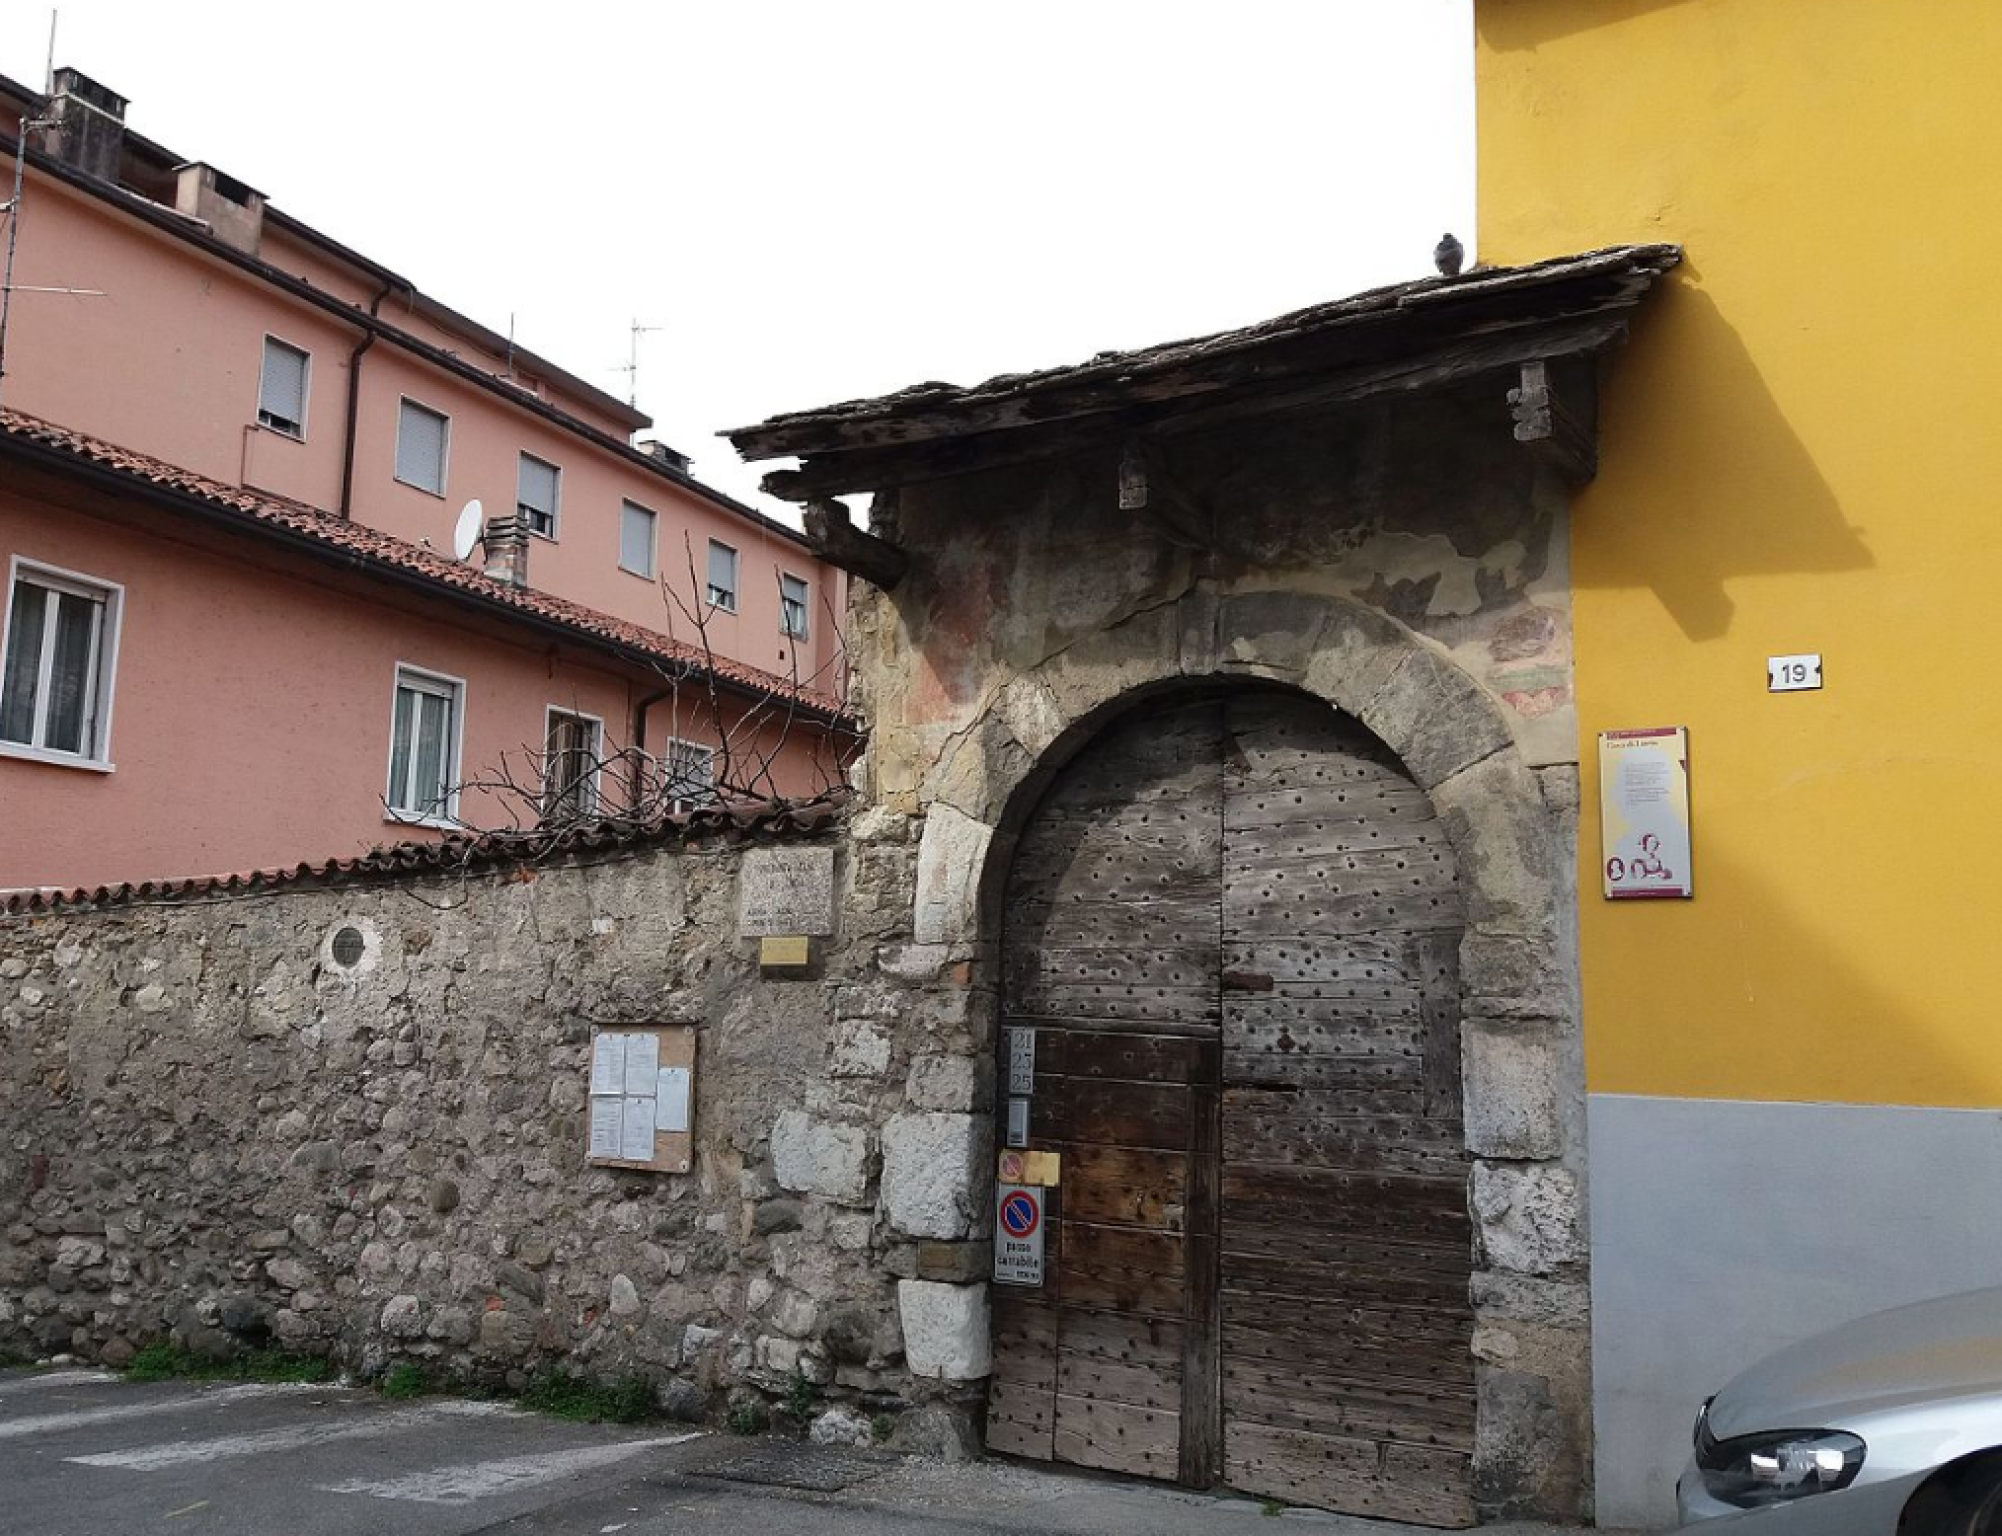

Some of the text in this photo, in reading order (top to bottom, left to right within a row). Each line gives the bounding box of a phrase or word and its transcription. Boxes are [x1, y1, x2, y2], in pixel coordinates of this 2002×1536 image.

[1782, 663, 1807, 683] 19
[1014, 1032, 1032, 1049] 21
[1012, 1051, 1032, 1070] 23
[1012, 1073, 1032, 1091] 25
[1006, 1241, 1032, 1254] passo
